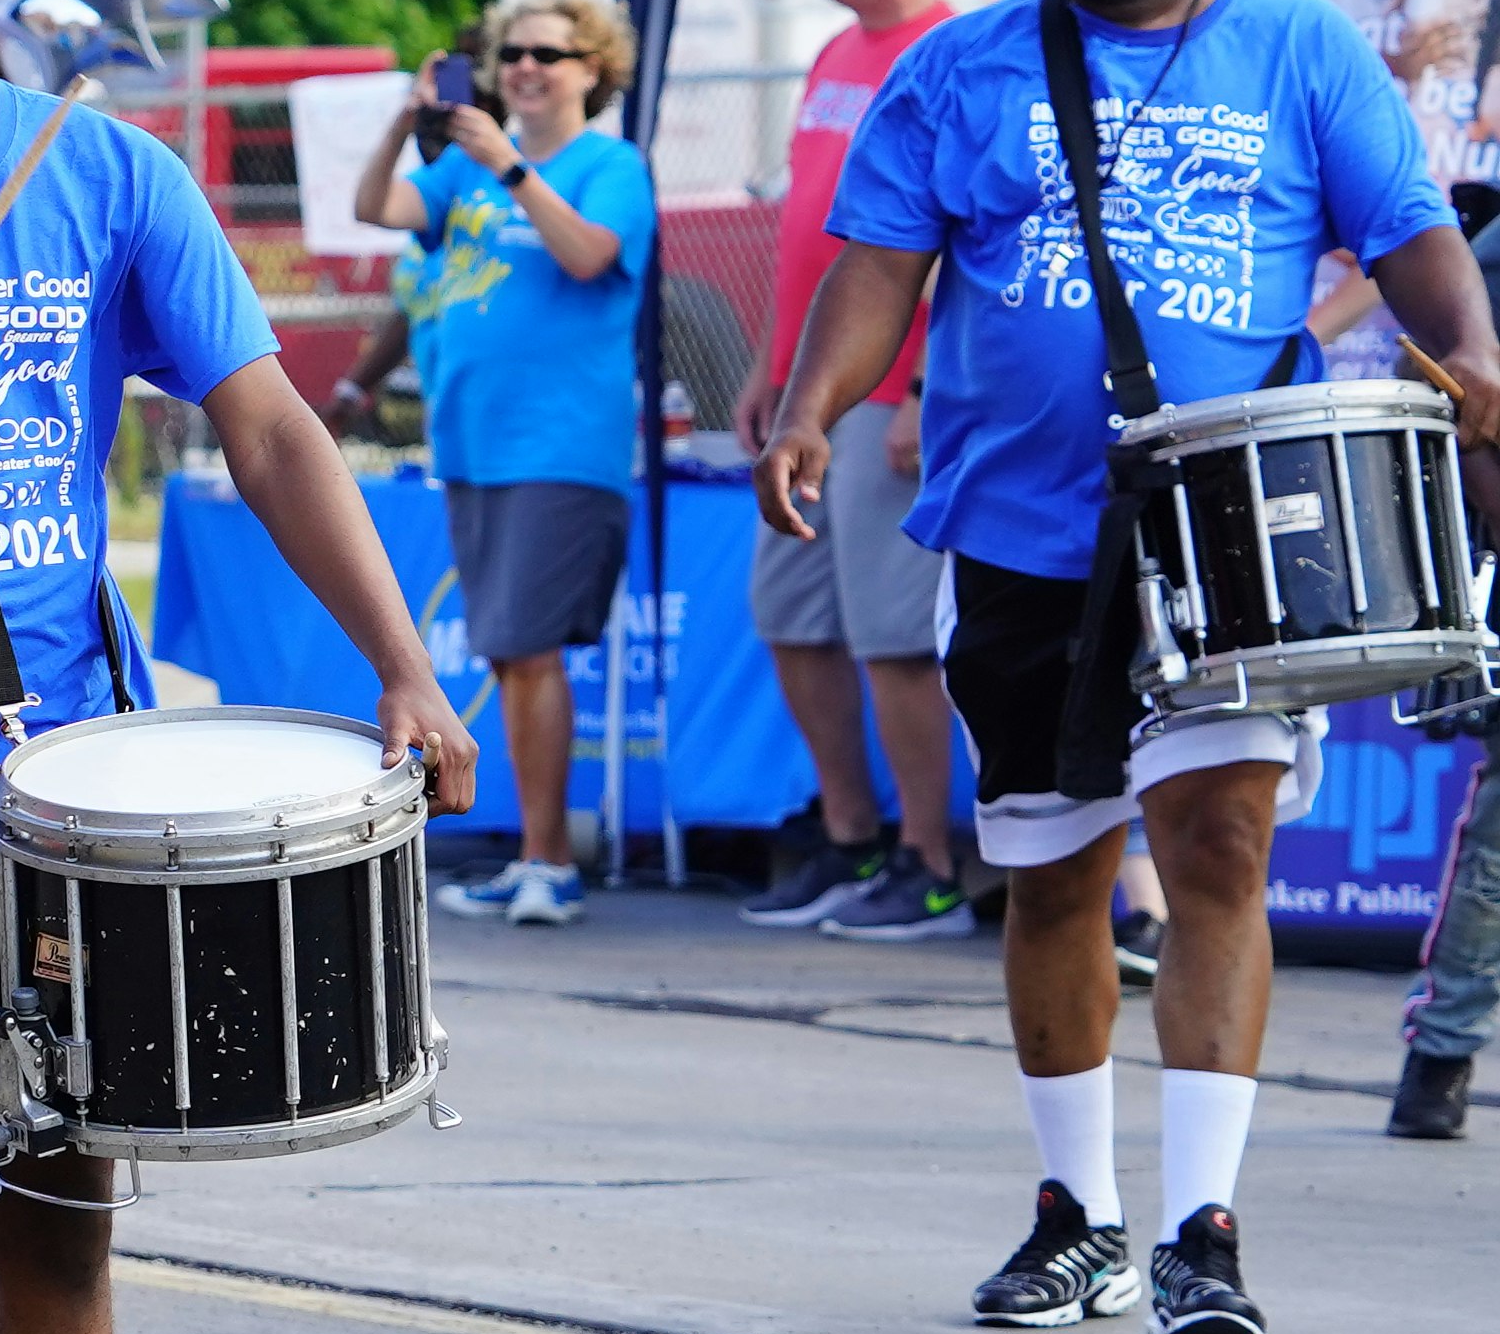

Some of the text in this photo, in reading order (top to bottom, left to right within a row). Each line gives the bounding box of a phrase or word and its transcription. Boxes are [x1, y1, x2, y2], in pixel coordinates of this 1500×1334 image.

[1416, 63, 1479, 119] be
[1210, 103, 1269, 132] Good
[1175, 125, 1265, 156] GOOD
[1171, 154, 1263, 202] Good
[24, 269, 91, 299] Good
[1037, 268, 1253, 330] Tor 2021
[1335, 879, 1438, 915] Public
